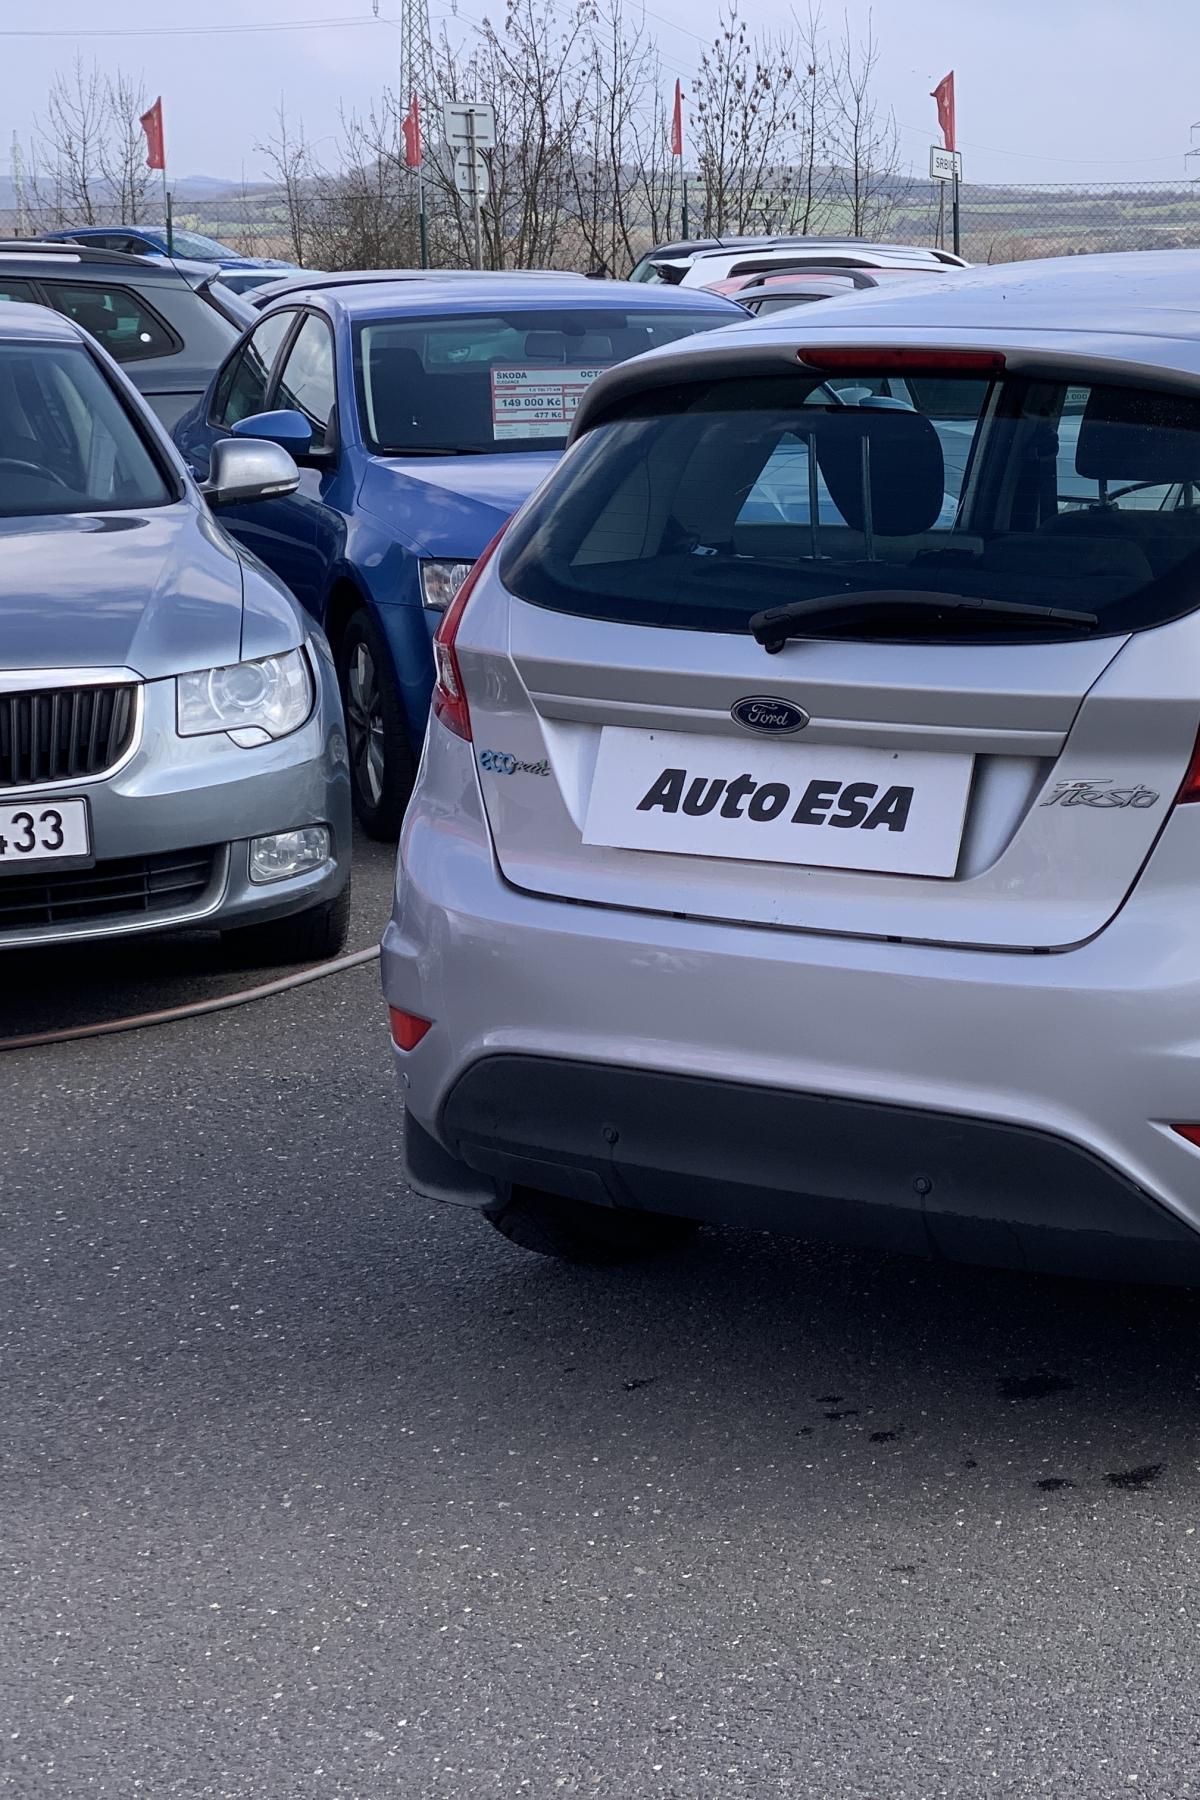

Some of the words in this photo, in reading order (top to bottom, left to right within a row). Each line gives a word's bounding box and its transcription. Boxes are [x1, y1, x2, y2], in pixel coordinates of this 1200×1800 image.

[502, 399, 521, 407] 149
[524, 398, 544, 407] 000
[547, 397, 561, 406] Kč
[748, 704, 789, 725] Ford
[635, 768, 791, 822] Auto
[790, 779, 915, 832] ESA
[1039, 779, 1160, 808] Fiesta
